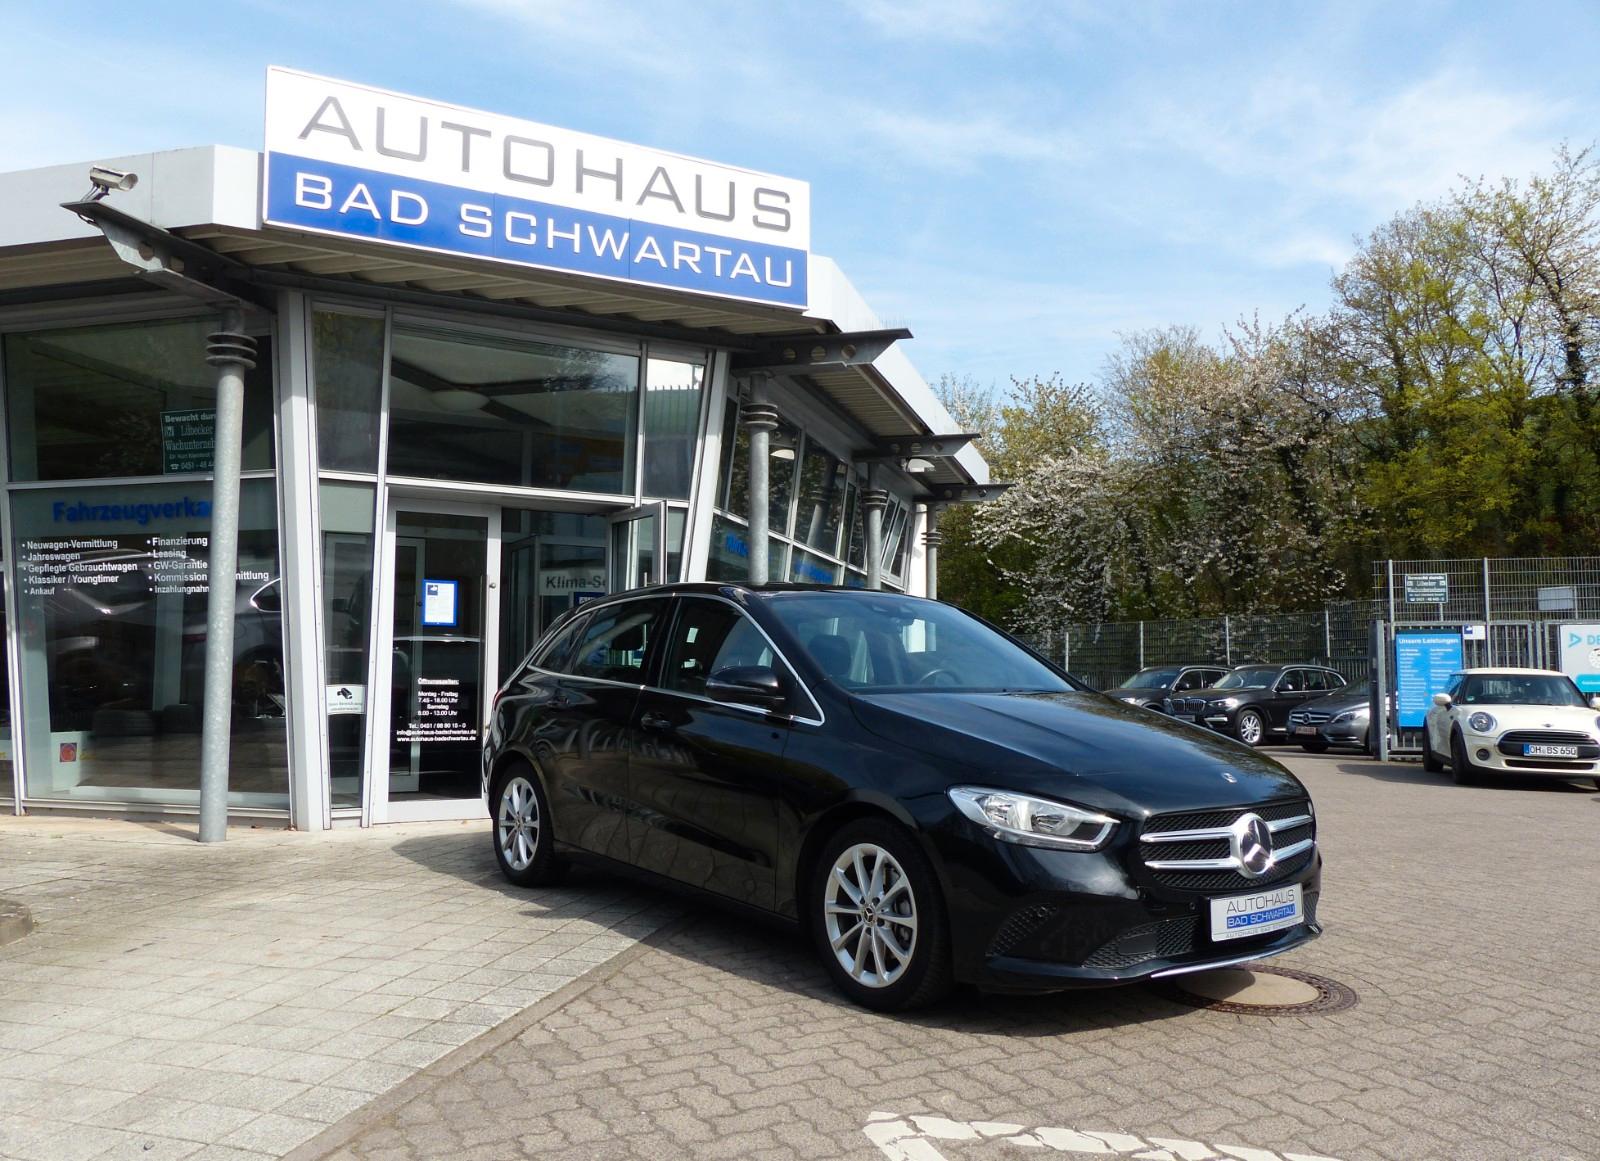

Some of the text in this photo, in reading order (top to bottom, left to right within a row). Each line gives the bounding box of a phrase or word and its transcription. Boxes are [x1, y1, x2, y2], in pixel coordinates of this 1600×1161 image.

[298, 95, 791, 233] AUTOHAUS
[295, 172, 793, 288] BAD SCHWARTAU
[53, 497, 213, 525] Fahrzeugverka
[27, 539, 118, 550] Neuwagen-Vermittlung
[152, 537, 208, 547] Finanzierung
[28, 552, 80, 562] Jahreswagen
[153, 549, 187, 559] Leasing
[28, 563, 138, 574] Gepflegte Gebrauchtwagen
[153, 560, 208, 570] GW-Garantie
[29, 576, 65, 585] Klassiker
[72, 574, 119, 585] Youngtimer
[30, 587, 55, 595] Ankauf
[1530, 745, 1541, 754] OH
[1546, 746, 1558, 755] BS
[1226, 889, 1295, 914] AUTOHAUS
[1227, 904, 1296, 927] BAD SCHWARTAU
